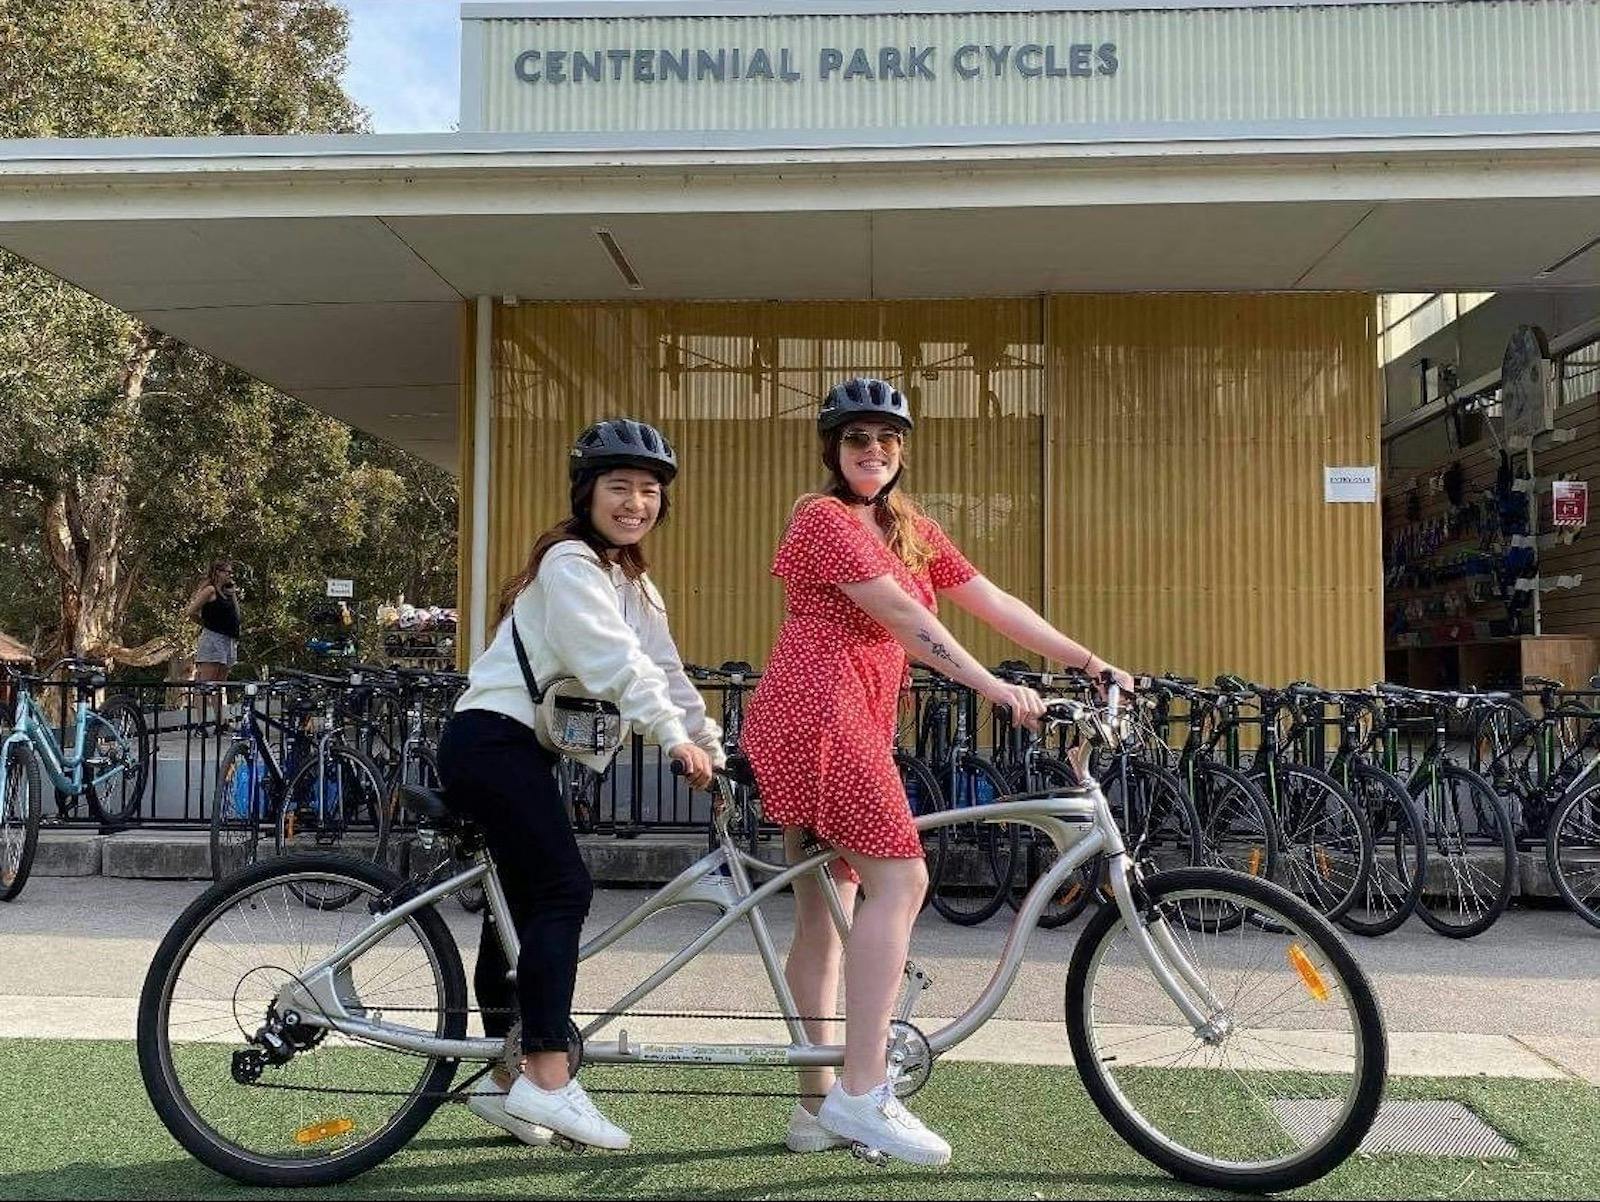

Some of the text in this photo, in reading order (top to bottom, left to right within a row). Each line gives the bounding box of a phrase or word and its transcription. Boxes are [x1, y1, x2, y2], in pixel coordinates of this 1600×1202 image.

[514, 42, 1120, 84] CENTENNIAL PARK CYCLES
